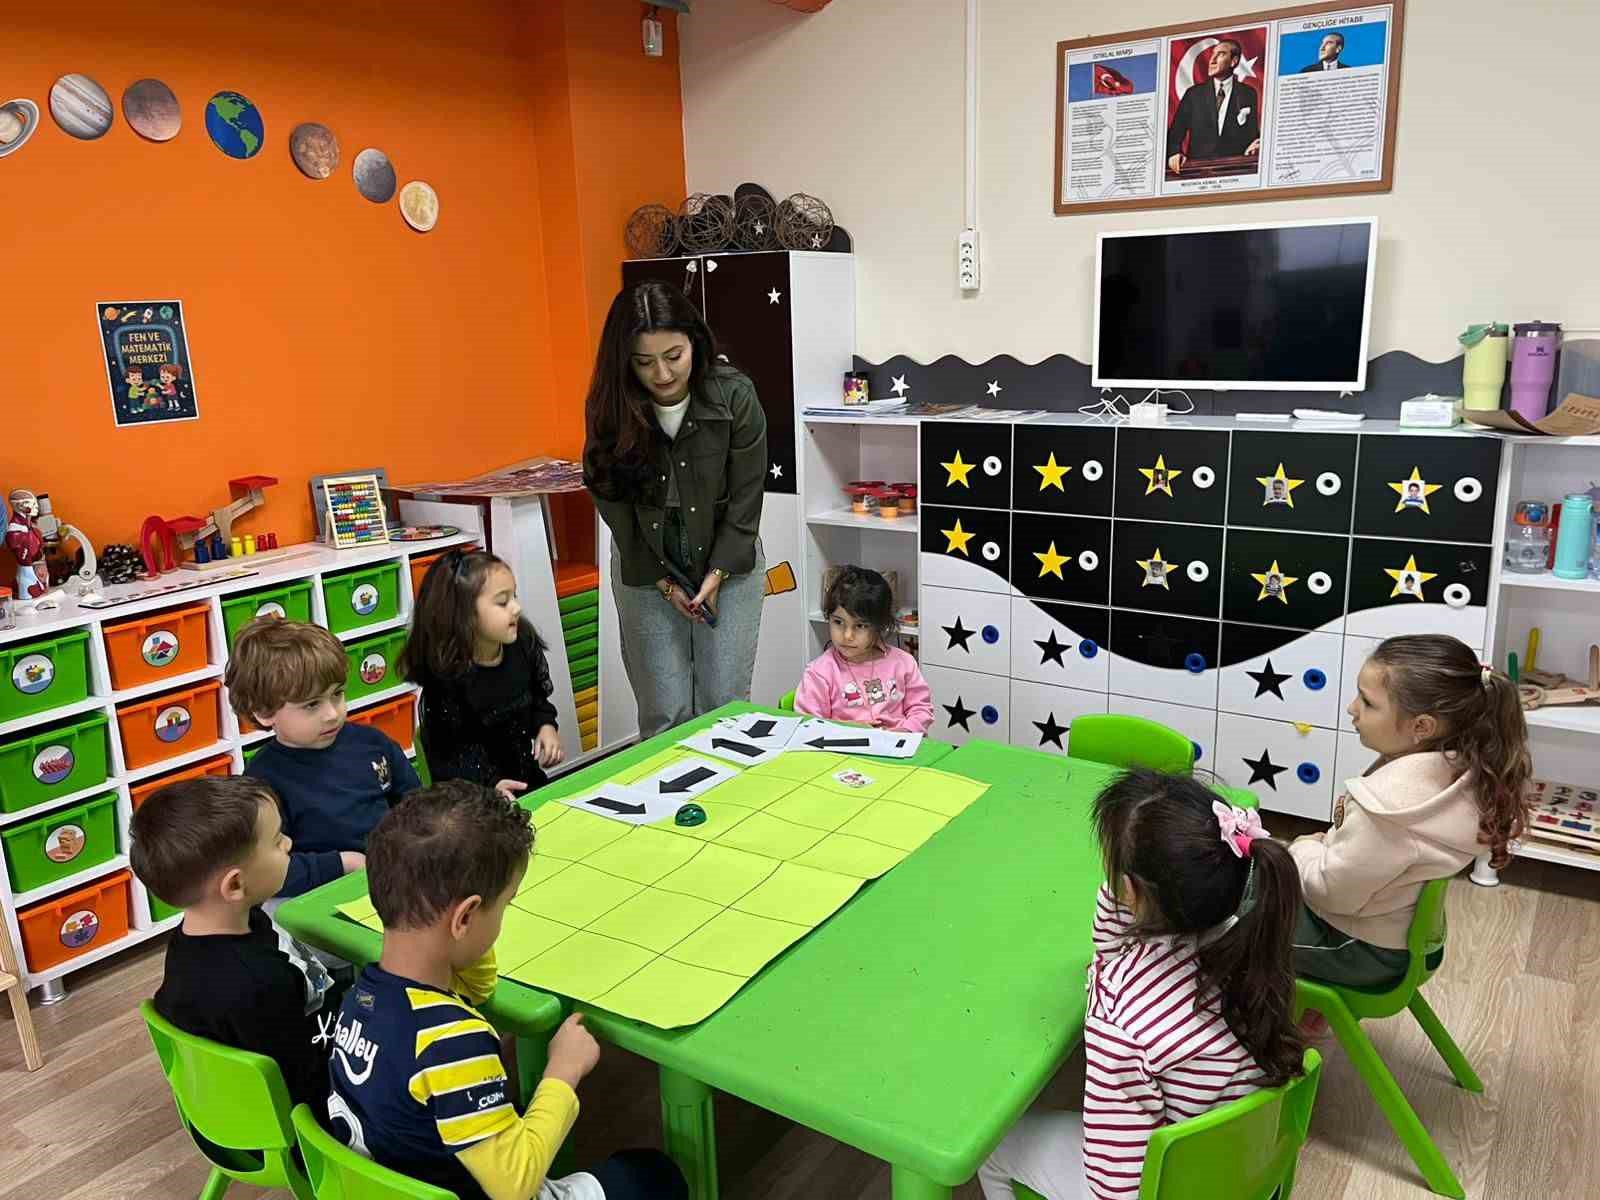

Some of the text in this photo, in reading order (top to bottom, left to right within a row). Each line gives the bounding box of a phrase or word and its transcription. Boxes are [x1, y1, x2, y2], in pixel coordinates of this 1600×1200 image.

[129, 331, 160, 342] FEN VE
[121, 342, 172, 353] MATEMATİK
[129, 353, 167, 363] MERKEZİ
